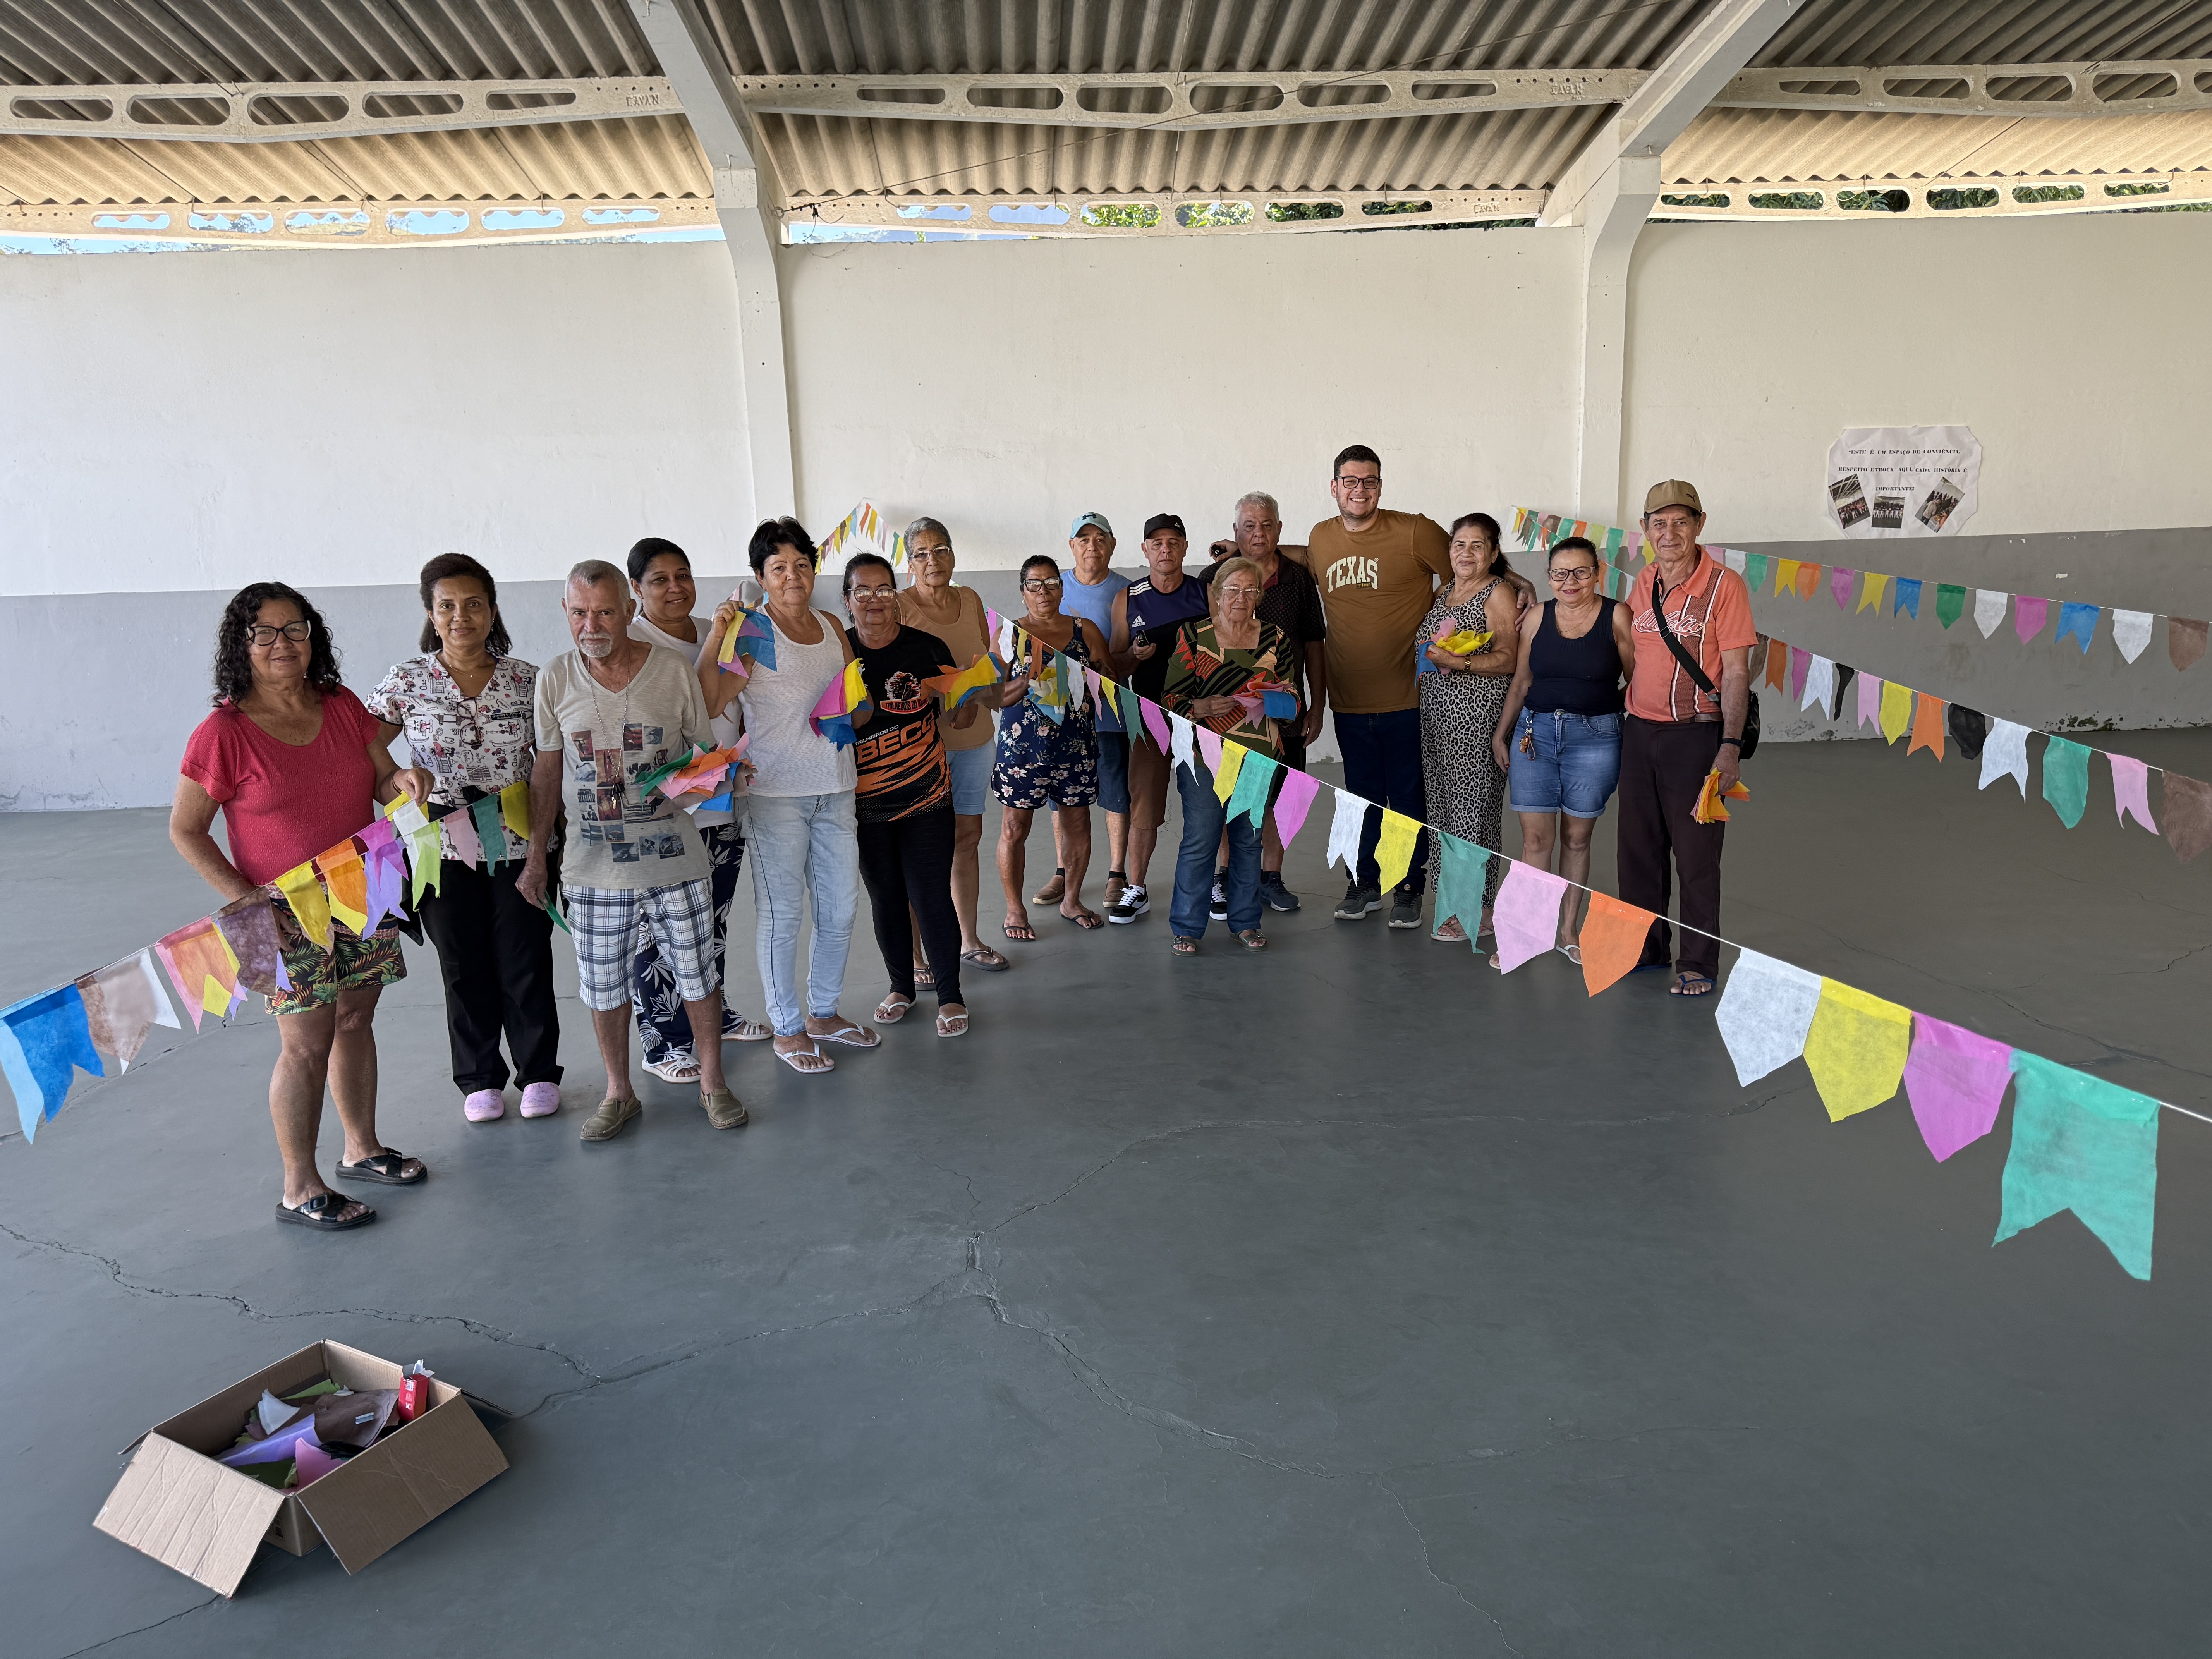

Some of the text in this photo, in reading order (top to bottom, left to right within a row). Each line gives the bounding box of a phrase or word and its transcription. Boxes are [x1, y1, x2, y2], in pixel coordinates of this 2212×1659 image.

[1326, 556, 1378, 594] TEXAS
[855, 728, 888, 746] TRILHEIROS
[856, 710, 936, 764] BECO
